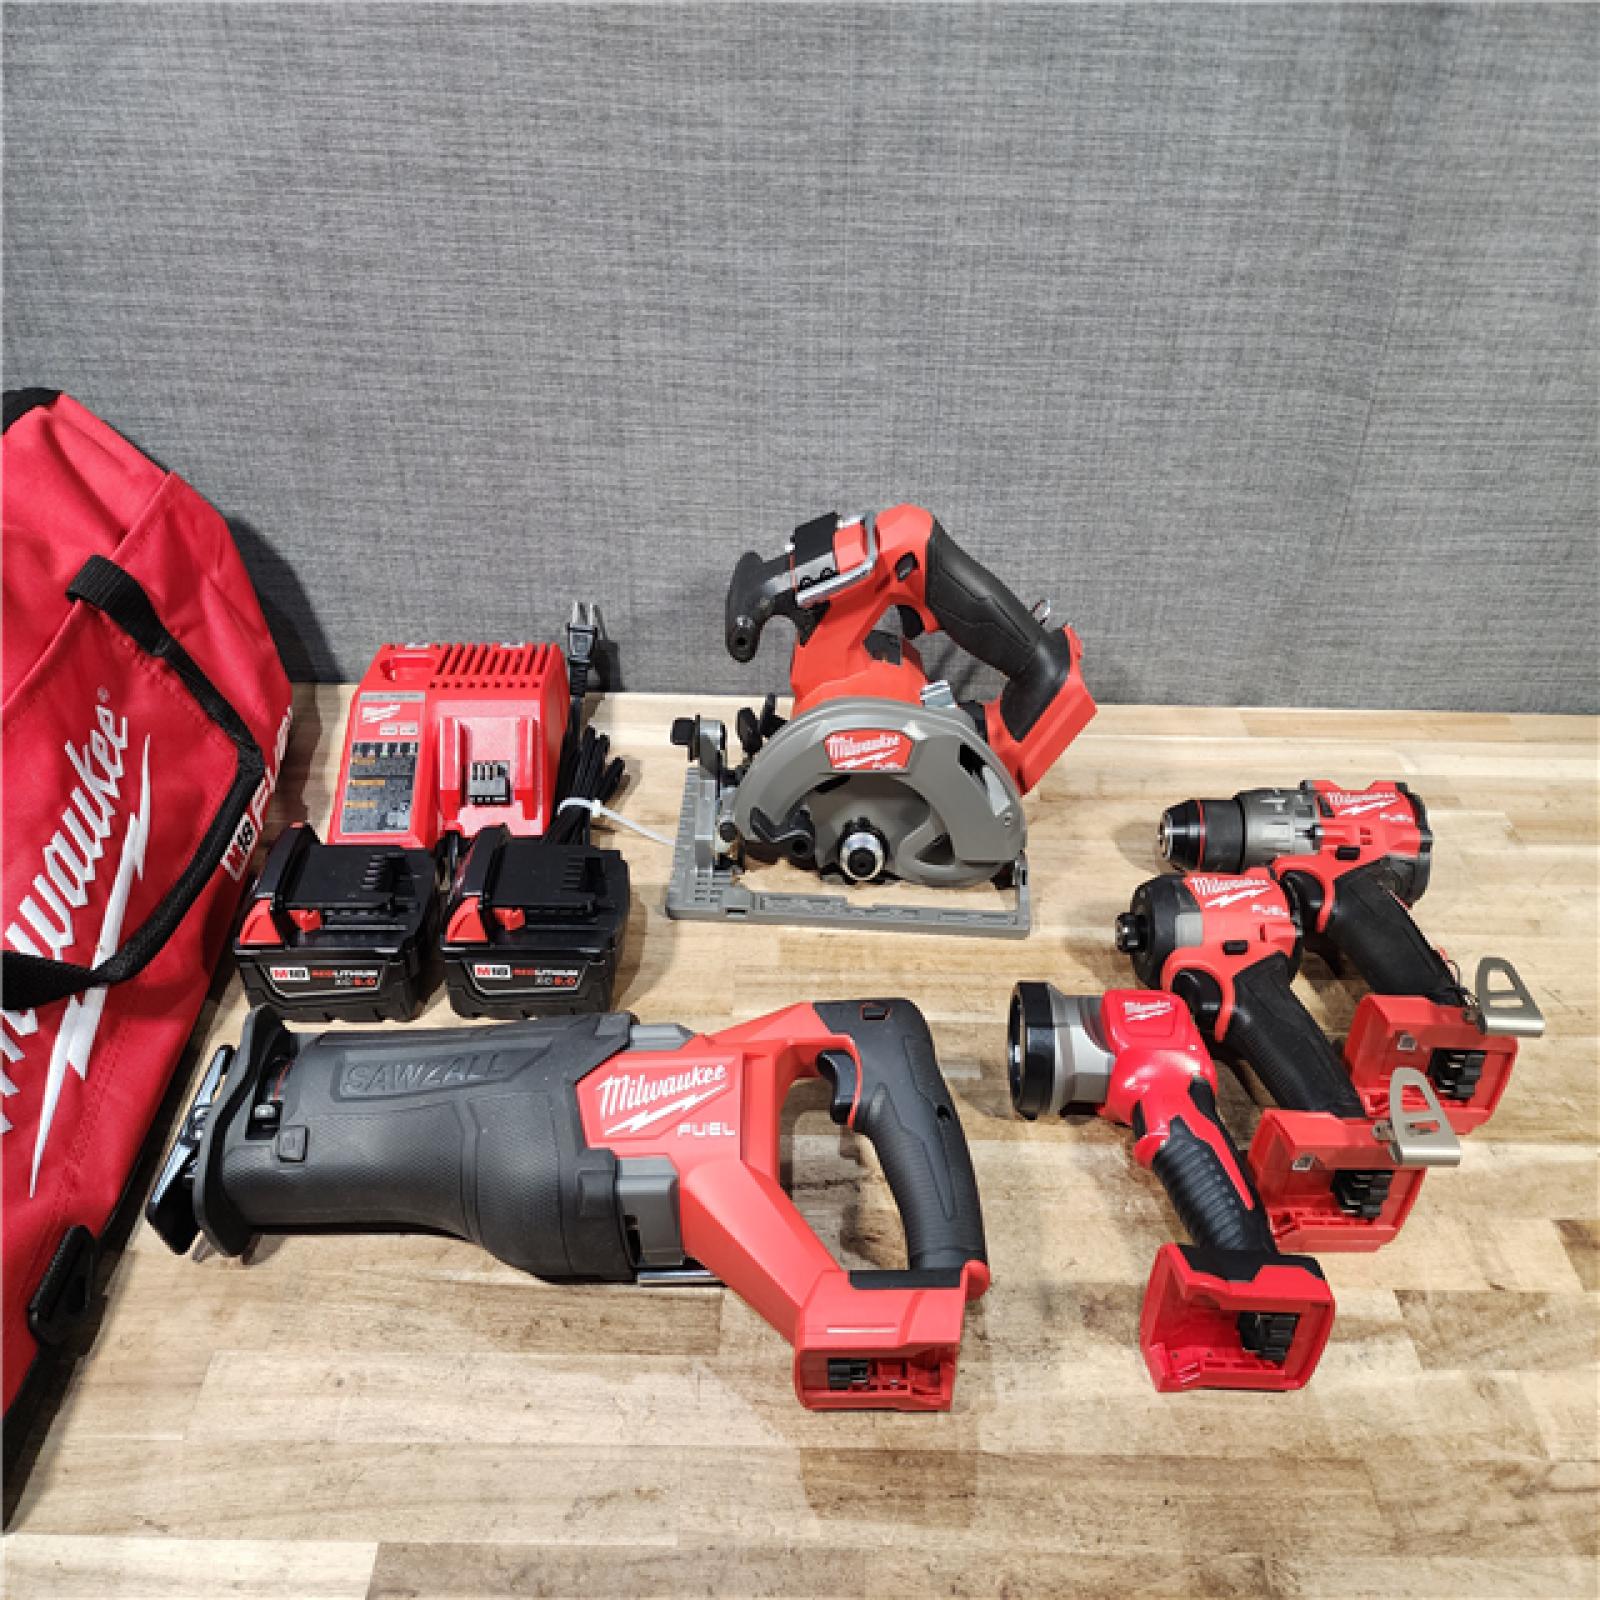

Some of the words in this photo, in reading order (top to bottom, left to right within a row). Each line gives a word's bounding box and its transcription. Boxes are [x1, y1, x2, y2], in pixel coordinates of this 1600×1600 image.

[344, 1051, 506, 1094] SAWZALL
[596, 1064, 730, 1119] Milwaukee
[677, 1121, 737, 1136] FUEL
